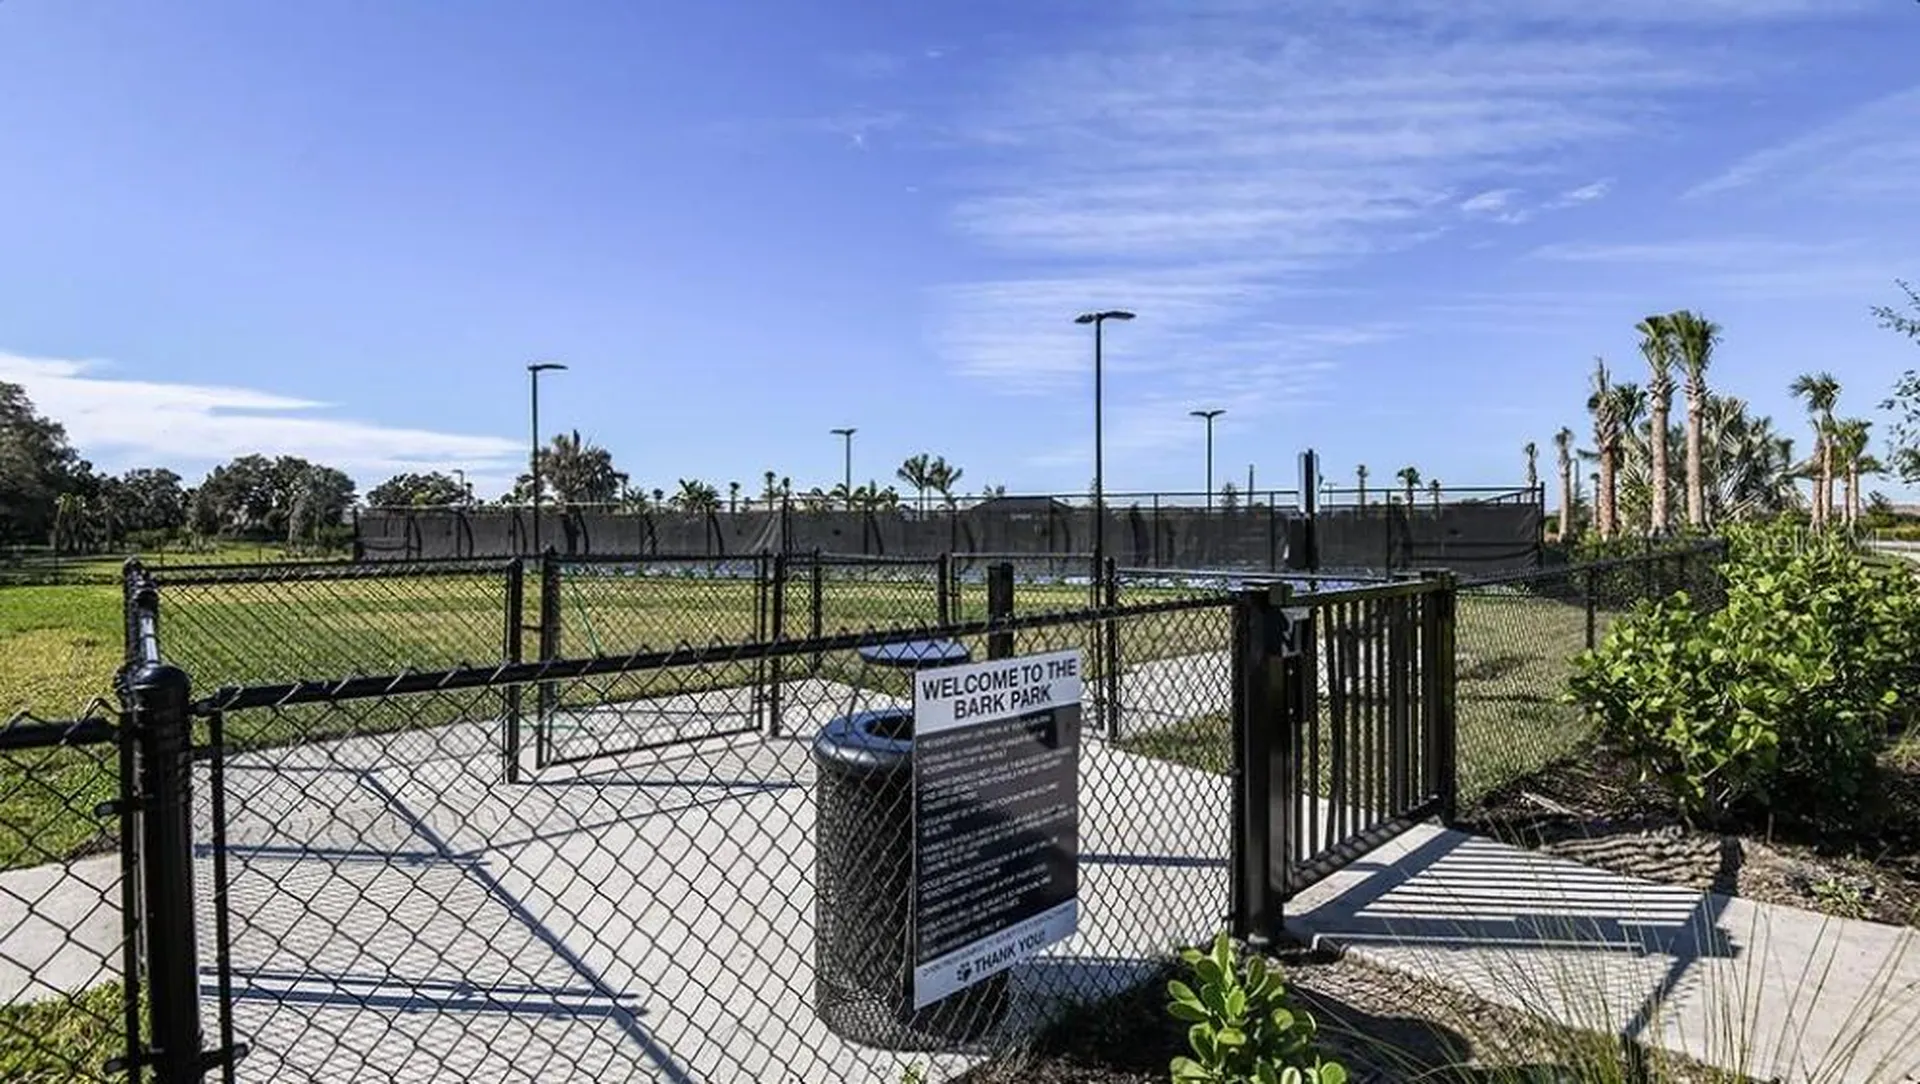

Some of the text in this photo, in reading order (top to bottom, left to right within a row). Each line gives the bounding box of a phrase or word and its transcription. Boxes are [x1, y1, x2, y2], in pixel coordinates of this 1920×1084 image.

[922, 658, 1077, 700] WELCOME TO THE
[954, 684, 1053, 720] BARK PARK
[974, 942, 1017, 974] THANK
